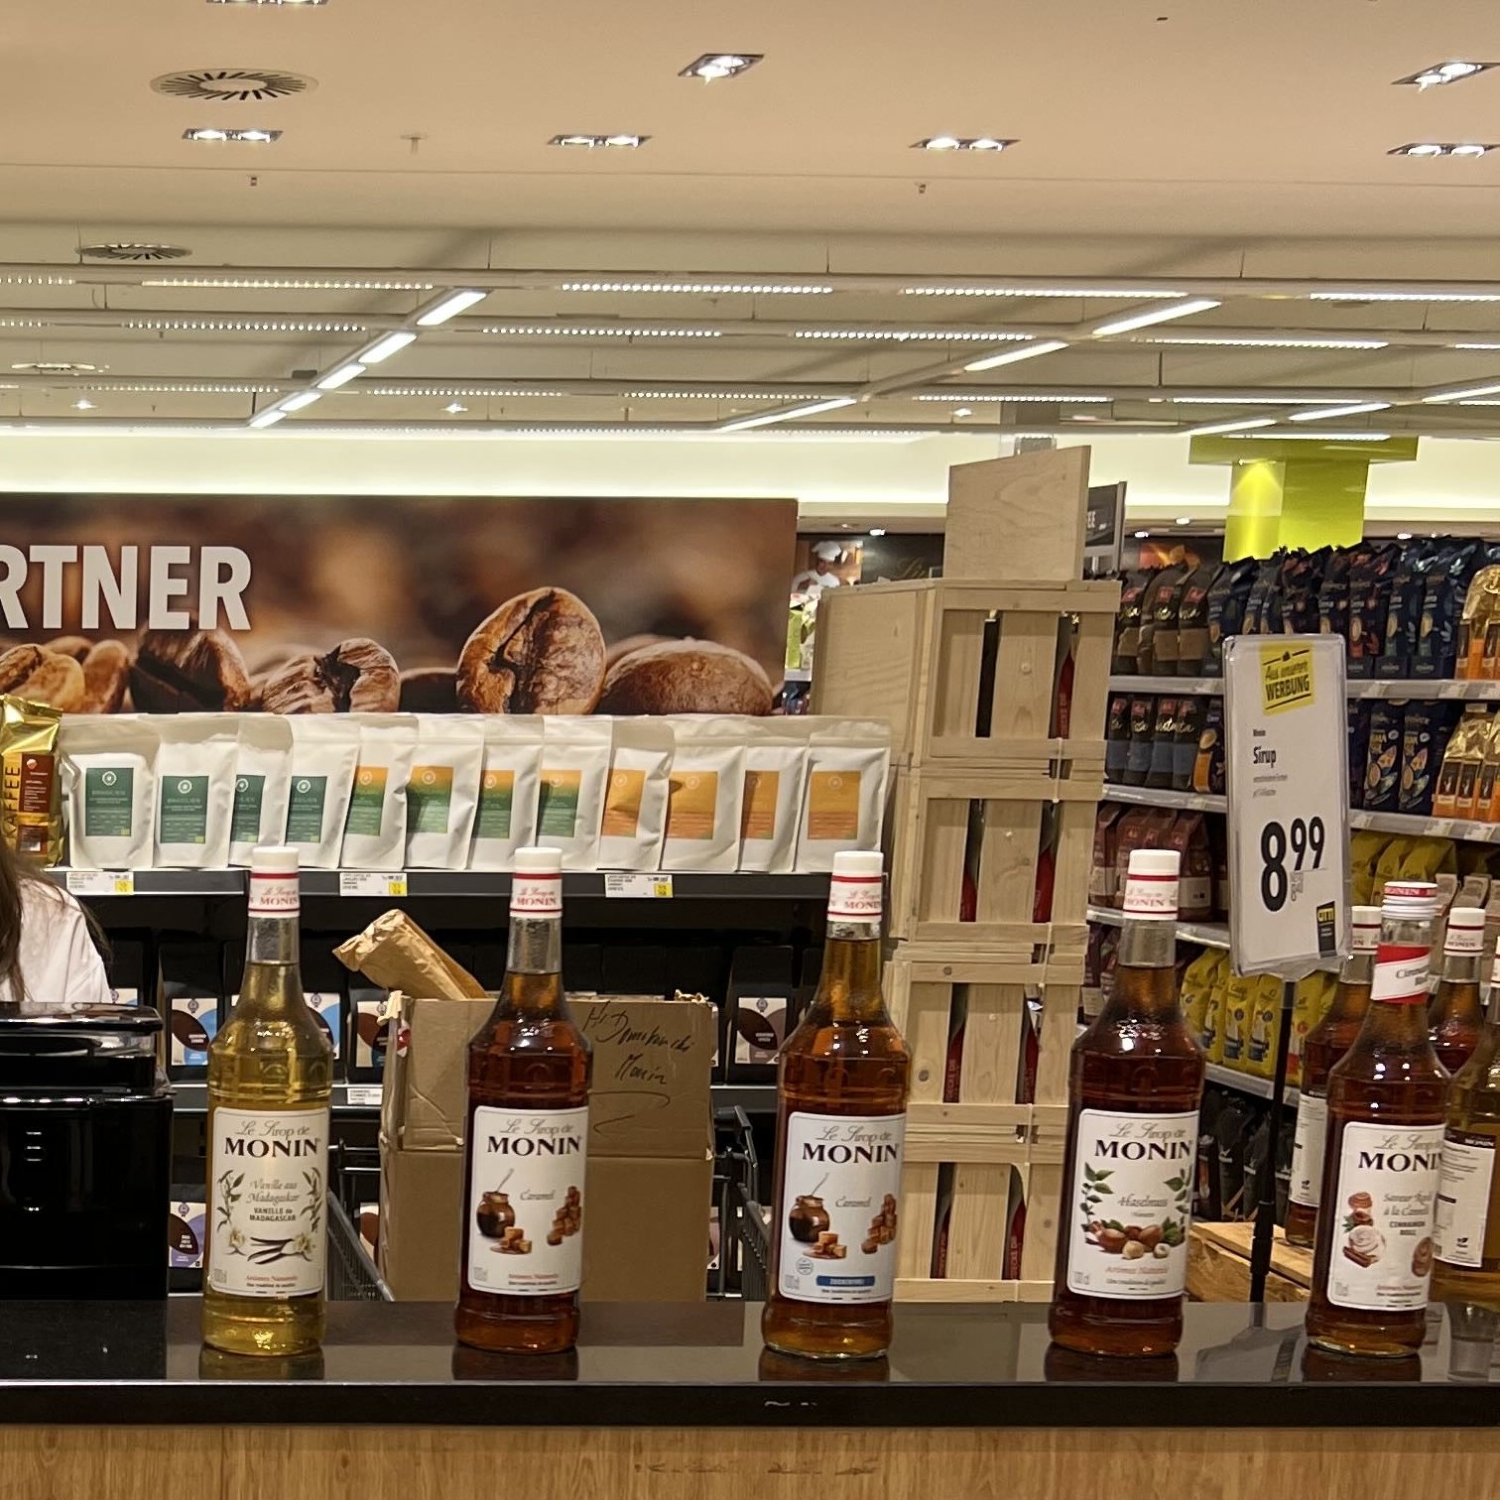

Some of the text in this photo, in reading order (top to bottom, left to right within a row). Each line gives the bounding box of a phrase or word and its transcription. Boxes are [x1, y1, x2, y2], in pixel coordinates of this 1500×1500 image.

[1265, 673, 1310, 702] WERBUNG
[1253, 746, 1277, 767] Sirup
[236, 1120, 310, 1140] Le Sirop de
[500, 1118, 573, 1137] Le Sirop de
[816, 1125, 892, 1146] Le Sirop de
[1108, 1122, 1134, 1138] Le
[1134, 1122, 1174, 1143] Sirop
[224, 1137, 319, 1158] MONIN
[487, 1136, 580, 1156] MONIN
[802, 1142, 897, 1163] MONIN
[1095, 1139, 1191, 1161] MONIN
[250, 1180, 283, 1190] Vanille
[249, 1214, 296, 1222] MADAGASCAR
